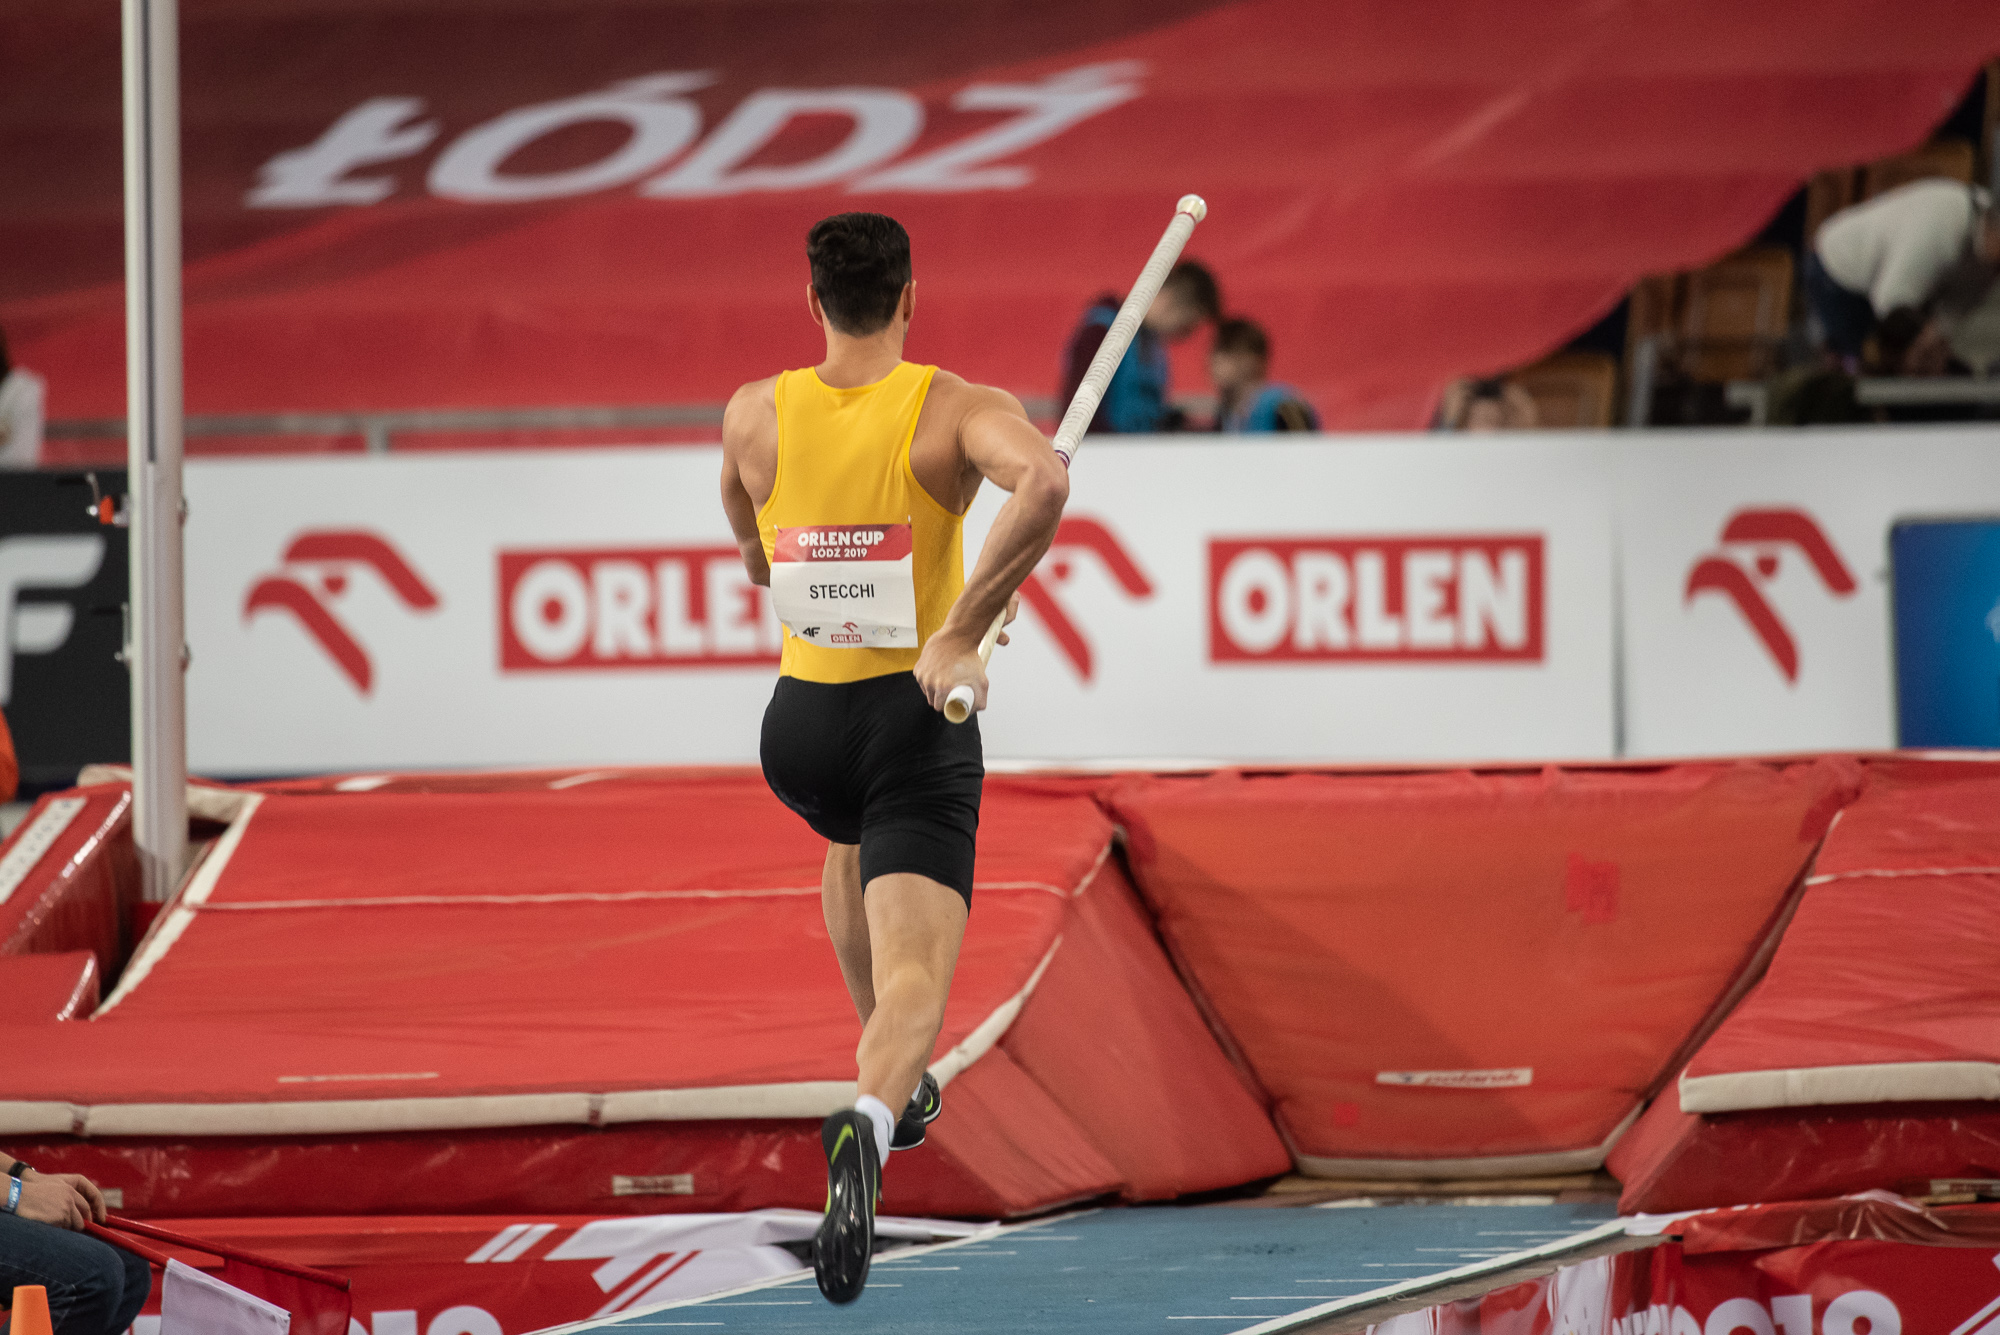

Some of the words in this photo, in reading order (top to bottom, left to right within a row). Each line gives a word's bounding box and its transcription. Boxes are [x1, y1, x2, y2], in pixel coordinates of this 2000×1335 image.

[247, 61, 1148, 207] ŁÓDŹ
[797, 532, 850, 546] ORLEN
[852, 531, 884, 545] CUP
[812, 546, 841, 558] ŁÓDŹ
[844, 548, 867, 558] 2019
[809, 583, 875, 599] STECCHI
[1217, 547, 1530, 652] ORLEN
[508, 557, 783, 662] ORLE
[802, 627, 820, 637] 4F
[832, 634, 862, 643] ORLEN
